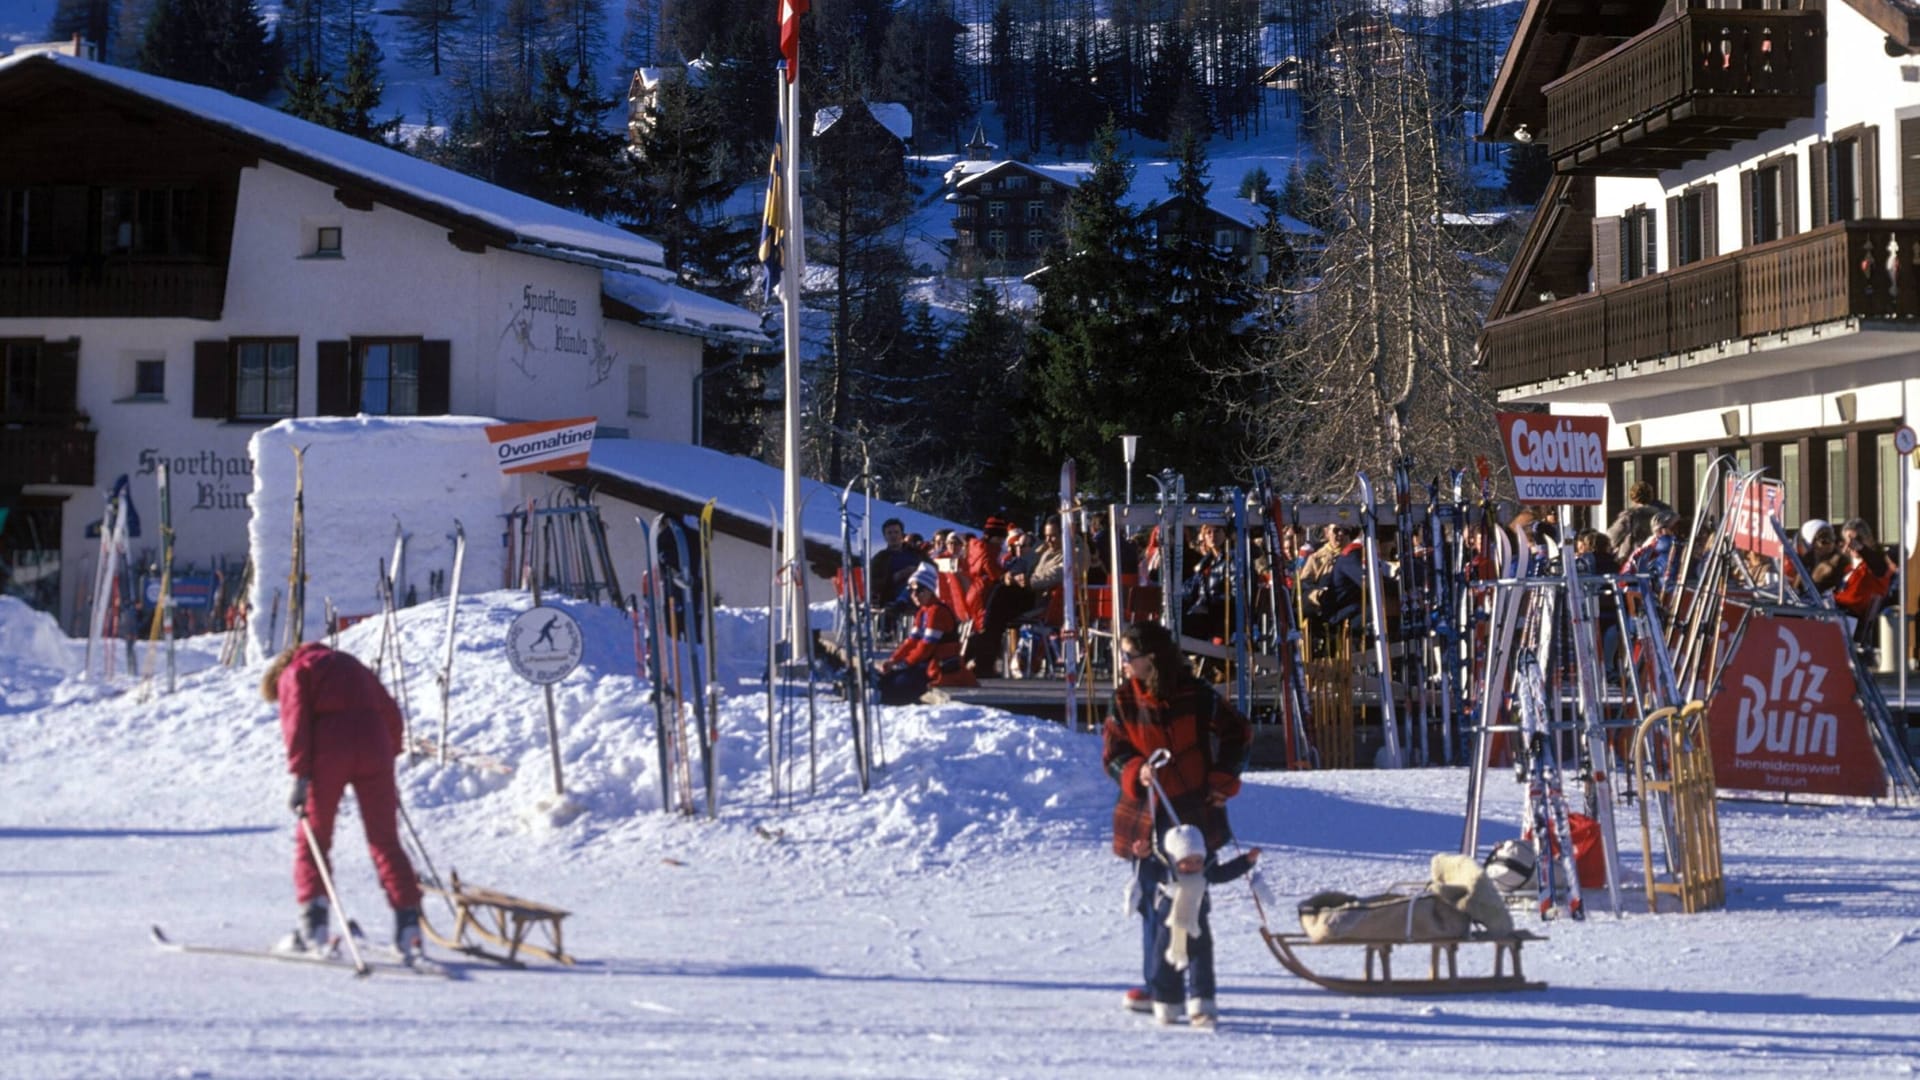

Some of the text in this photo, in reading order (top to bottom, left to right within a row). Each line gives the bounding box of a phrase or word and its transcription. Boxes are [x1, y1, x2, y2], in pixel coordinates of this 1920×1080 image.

[523, 282, 577, 320] Sporthaus
[498, 429, 593, 459] Ovomaltine
[1511, 418, 1604, 473] Caotina
[1525, 479, 1597, 498] chocolat surfin
[1769, 625, 1828, 704] Piz
[1735, 674, 1838, 757] Buin
[1735, 757, 1841, 775] beneidenswert
[1765, 773, 1808, 787] braun
